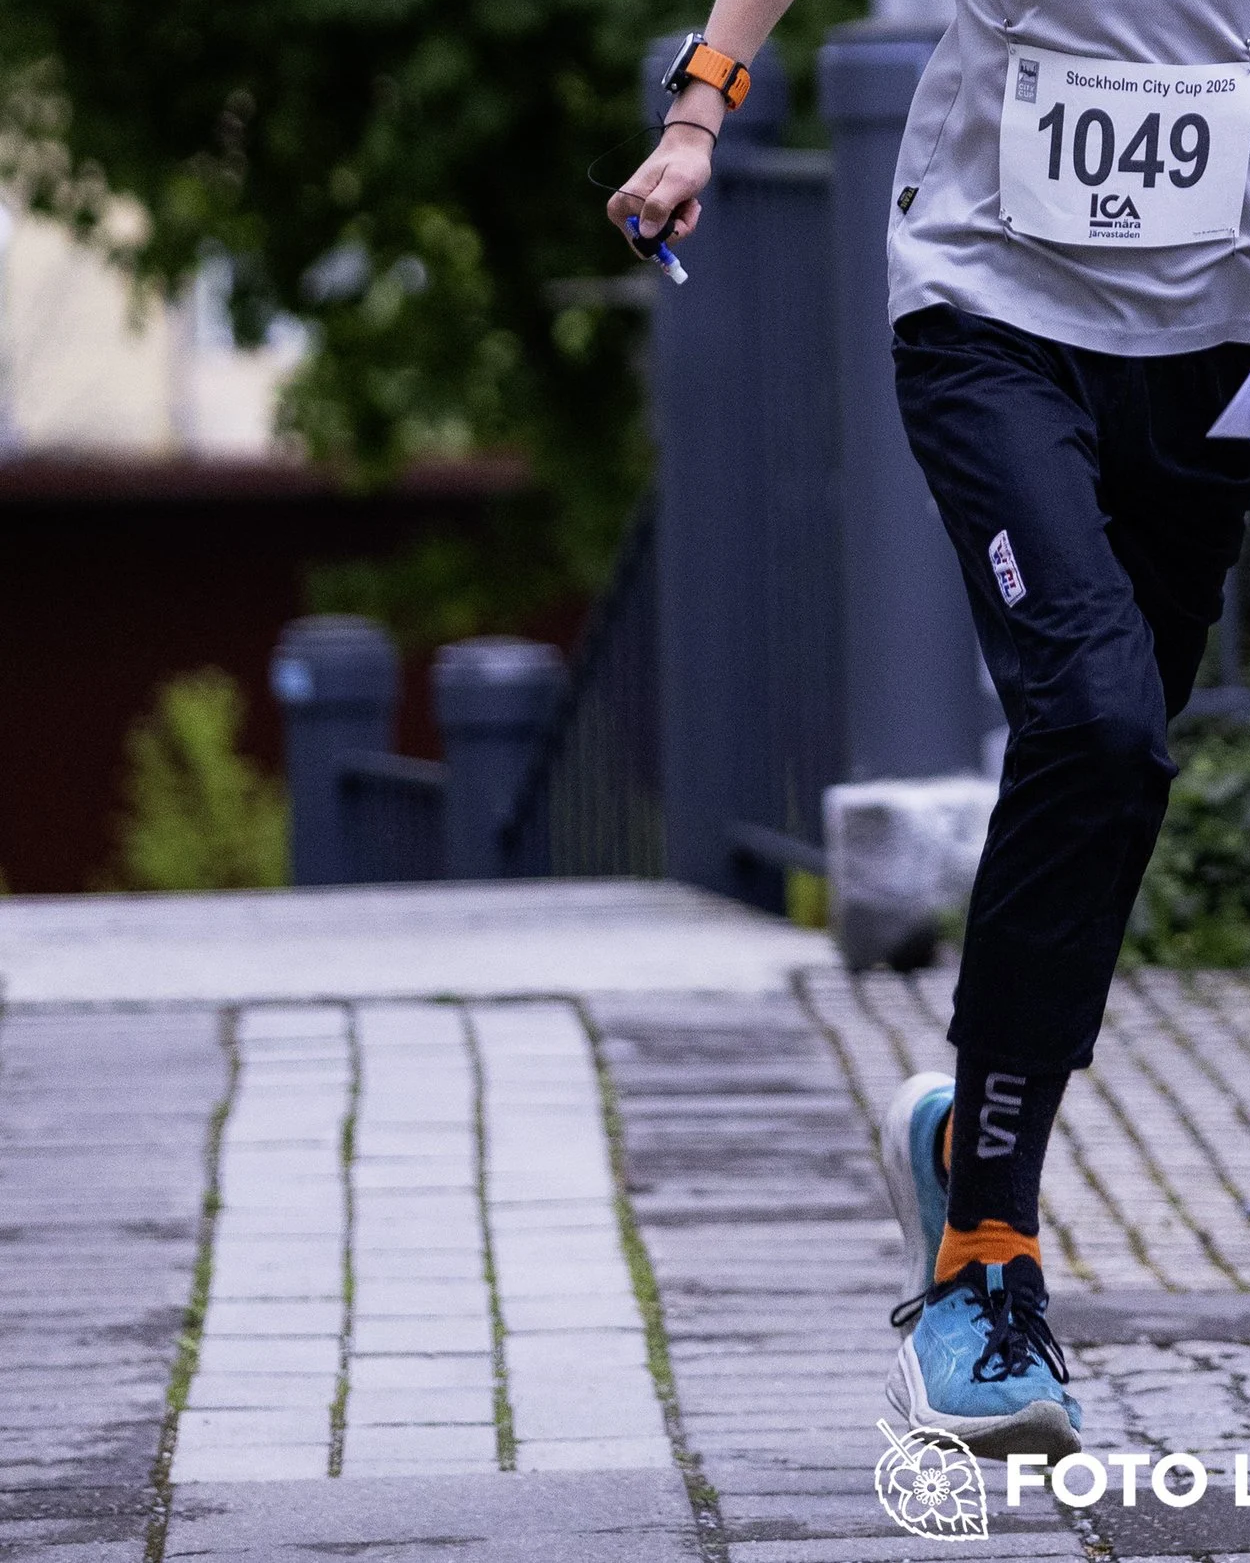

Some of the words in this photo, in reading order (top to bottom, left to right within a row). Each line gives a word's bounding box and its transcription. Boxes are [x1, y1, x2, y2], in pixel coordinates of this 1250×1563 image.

[1066, 70, 1138, 92] Stockholm
[1142, 79, 1171, 97] City
[1175, 80, 1202, 97] Cup
[1206, 78, 1236, 93] 2025
[1017, 89, 1035, 98] CUP
[1038, 102, 1211, 188] 1049
[1090, 193, 1141, 219] ICA
[1114, 219, 1141, 229] nära
[1089, 229, 1141, 239] Järvastaden
